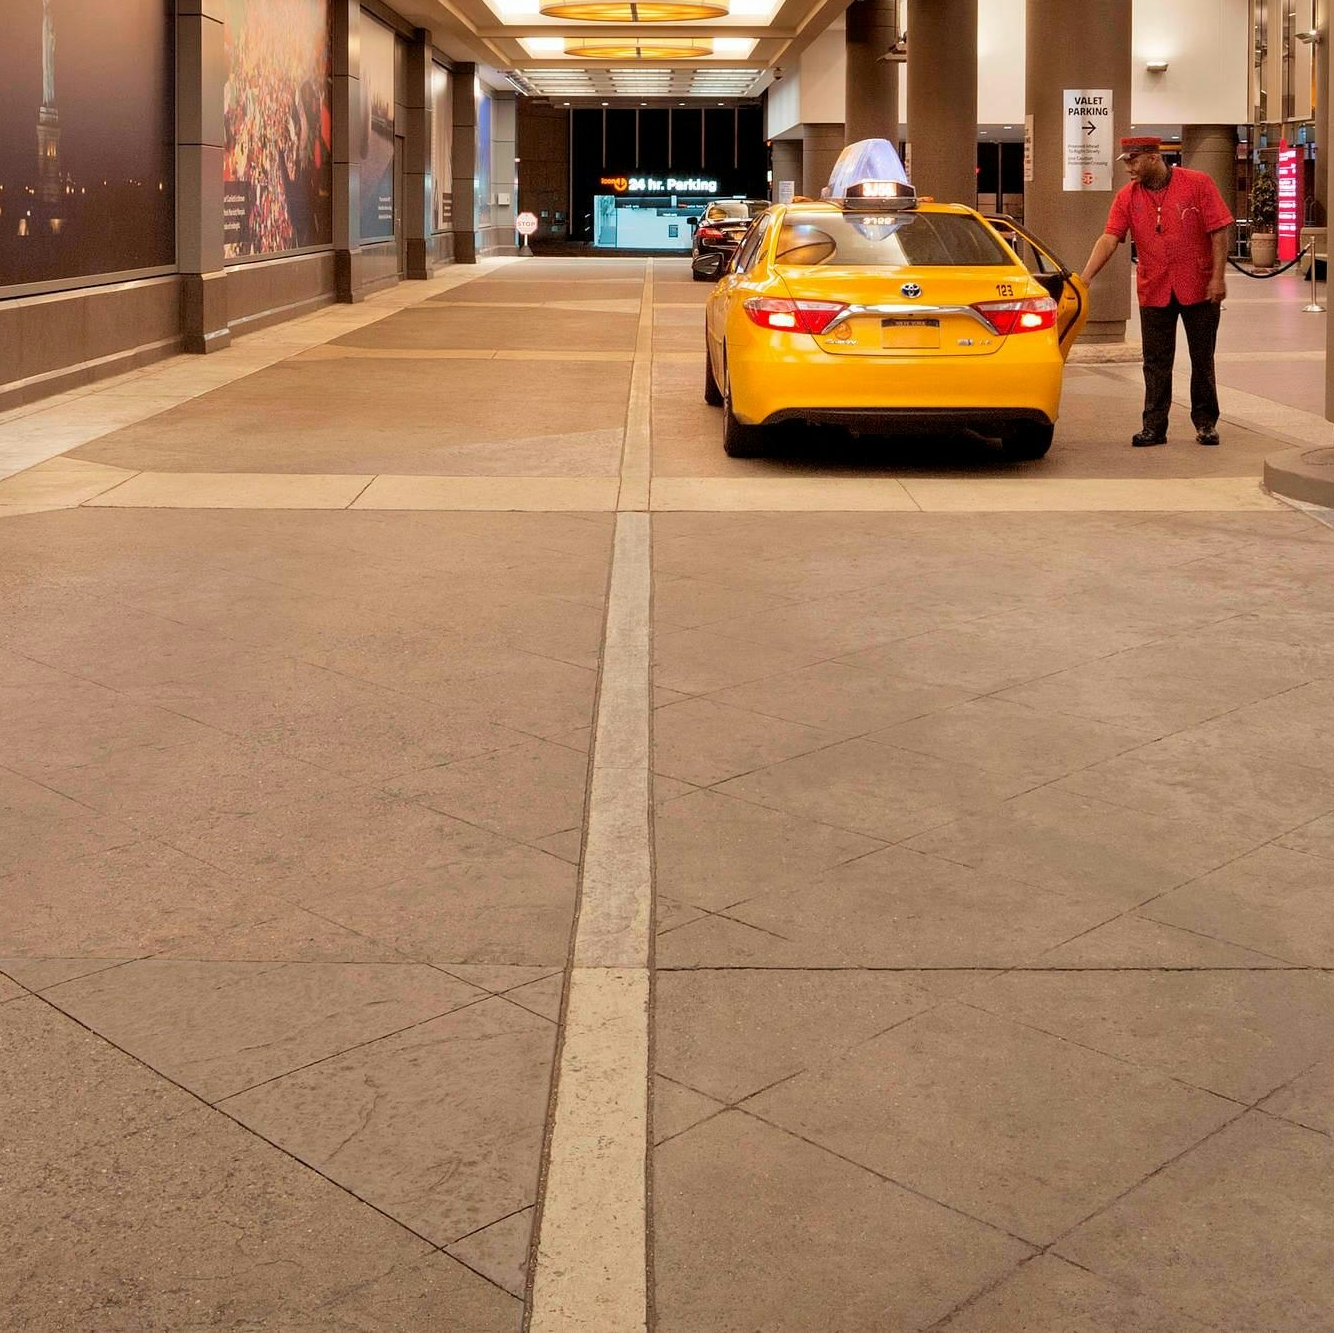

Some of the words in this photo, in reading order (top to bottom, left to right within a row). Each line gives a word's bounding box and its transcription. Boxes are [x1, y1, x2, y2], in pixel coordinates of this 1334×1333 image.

[1074, 97, 1103, 105] VALET
[1068, 107, 1108, 116] PARKING
[628, 177, 645, 191] 24
[647, 177, 665, 191] hr.
[666, 177, 717, 193] Parking
[517, 220, 536, 228] STOP
[996, 284, 1014, 297] 123
